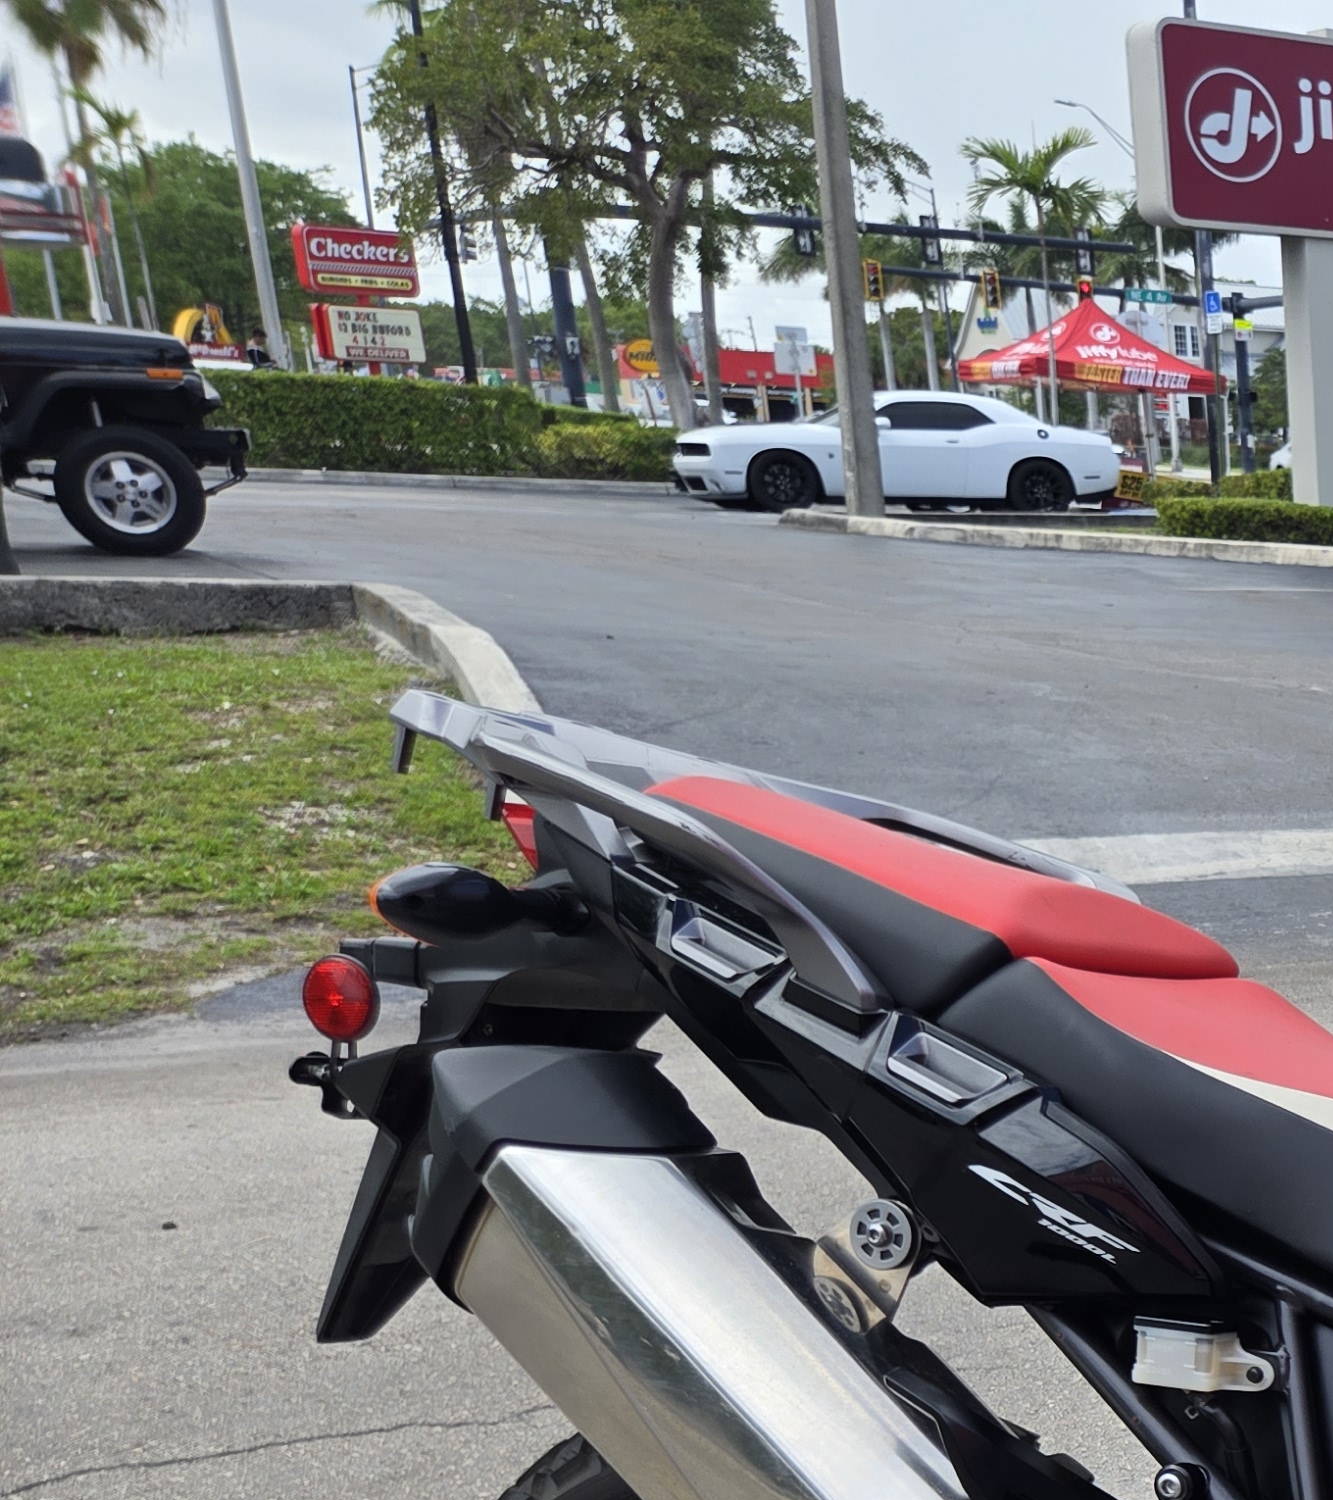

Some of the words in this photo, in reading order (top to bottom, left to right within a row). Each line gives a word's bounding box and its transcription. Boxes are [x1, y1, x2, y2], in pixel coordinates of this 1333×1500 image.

[1123, 366, 1156, 387] THAN
[967, 1164, 1141, 1253] CRF
[1037, 1218, 1117, 1265] 1000L
